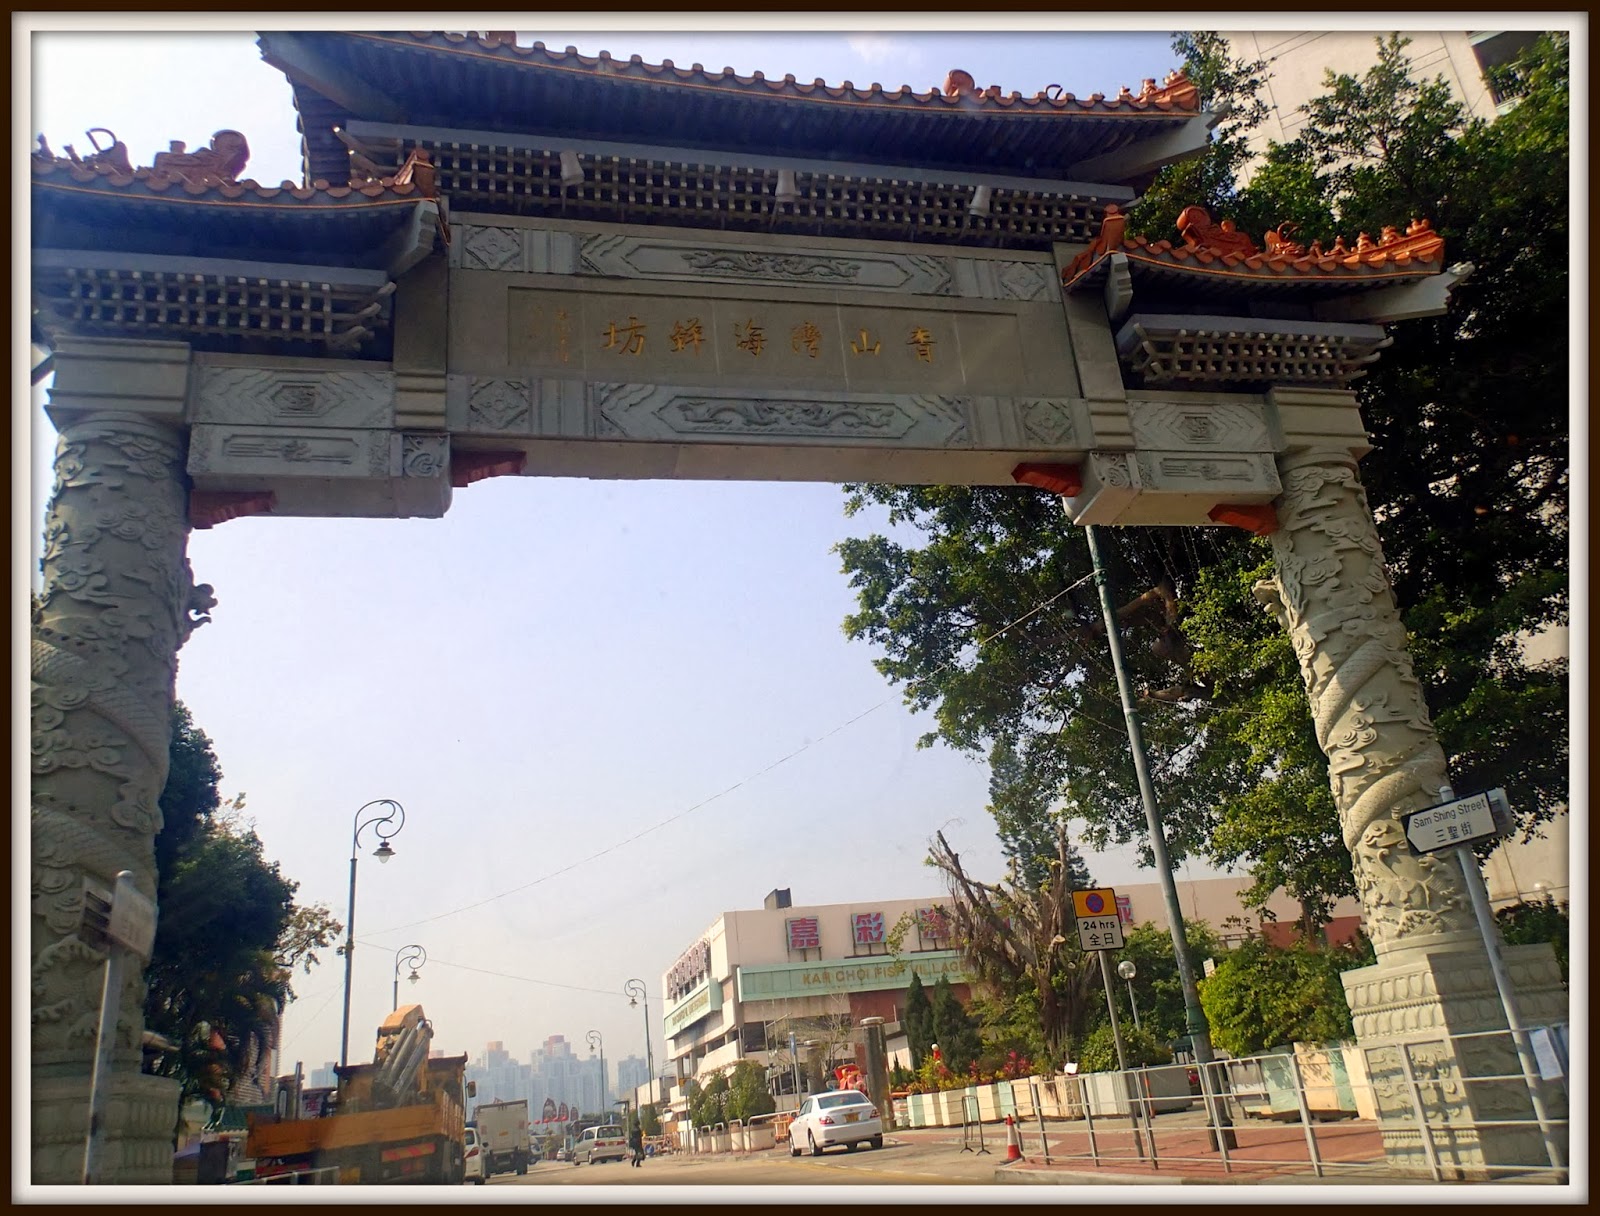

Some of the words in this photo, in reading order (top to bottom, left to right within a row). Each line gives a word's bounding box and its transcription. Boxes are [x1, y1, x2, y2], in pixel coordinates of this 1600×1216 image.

[1413, 818, 1433, 829] Sam
[1433, 808, 1457, 823] Shing
[1457, 798, 1487, 815] Street
[1435, 821, 1472, 843] 三聖街
[1083, 921, 1097, 931] 24
[1099, 919, 1115, 930] hrs
[1089, 932, 1115, 947] 全日
[803, 970, 831, 985] KAR
[835, 967, 870, 983] CHOI
